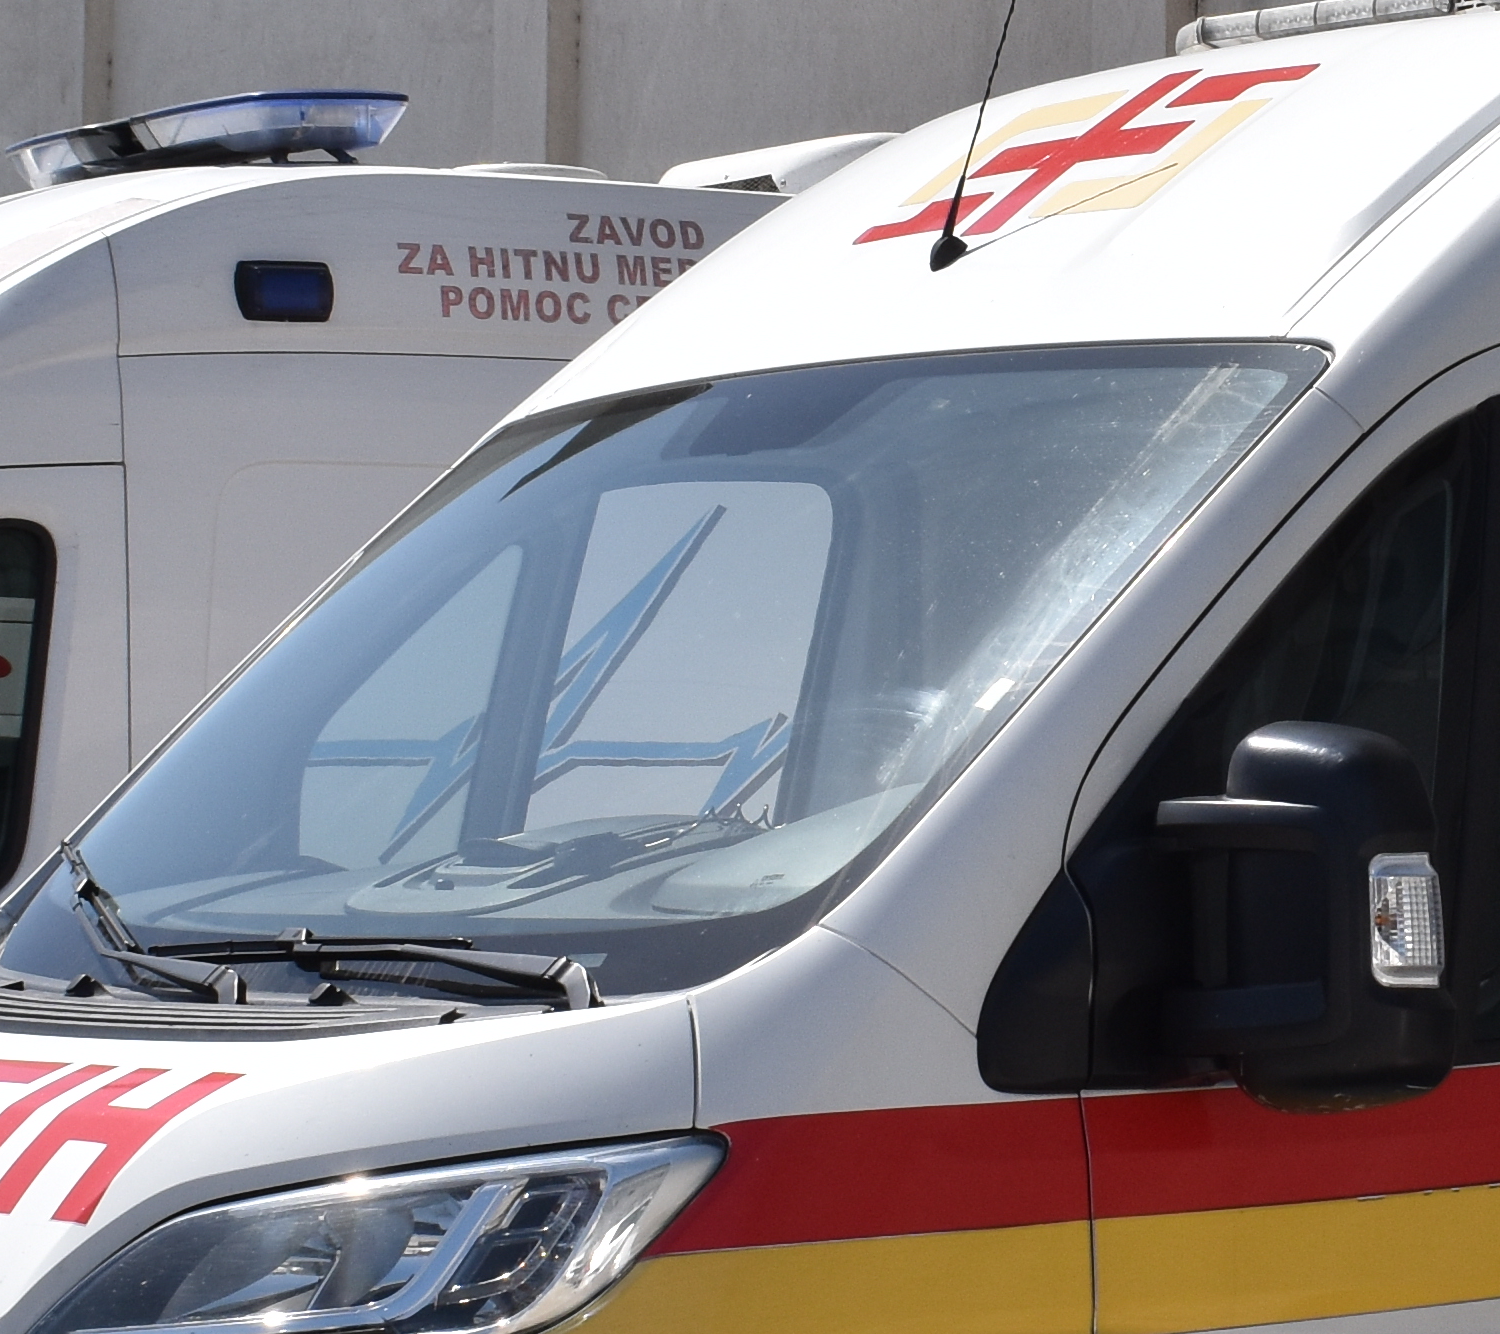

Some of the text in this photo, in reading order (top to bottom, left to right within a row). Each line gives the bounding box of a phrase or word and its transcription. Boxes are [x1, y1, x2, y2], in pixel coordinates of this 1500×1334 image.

[566, 213, 704, 250] ZAVOD
[397, 243, 454, 276] ZA
[467, 246, 600, 284] HITNU
[440, 285, 651, 326] POMOC C
